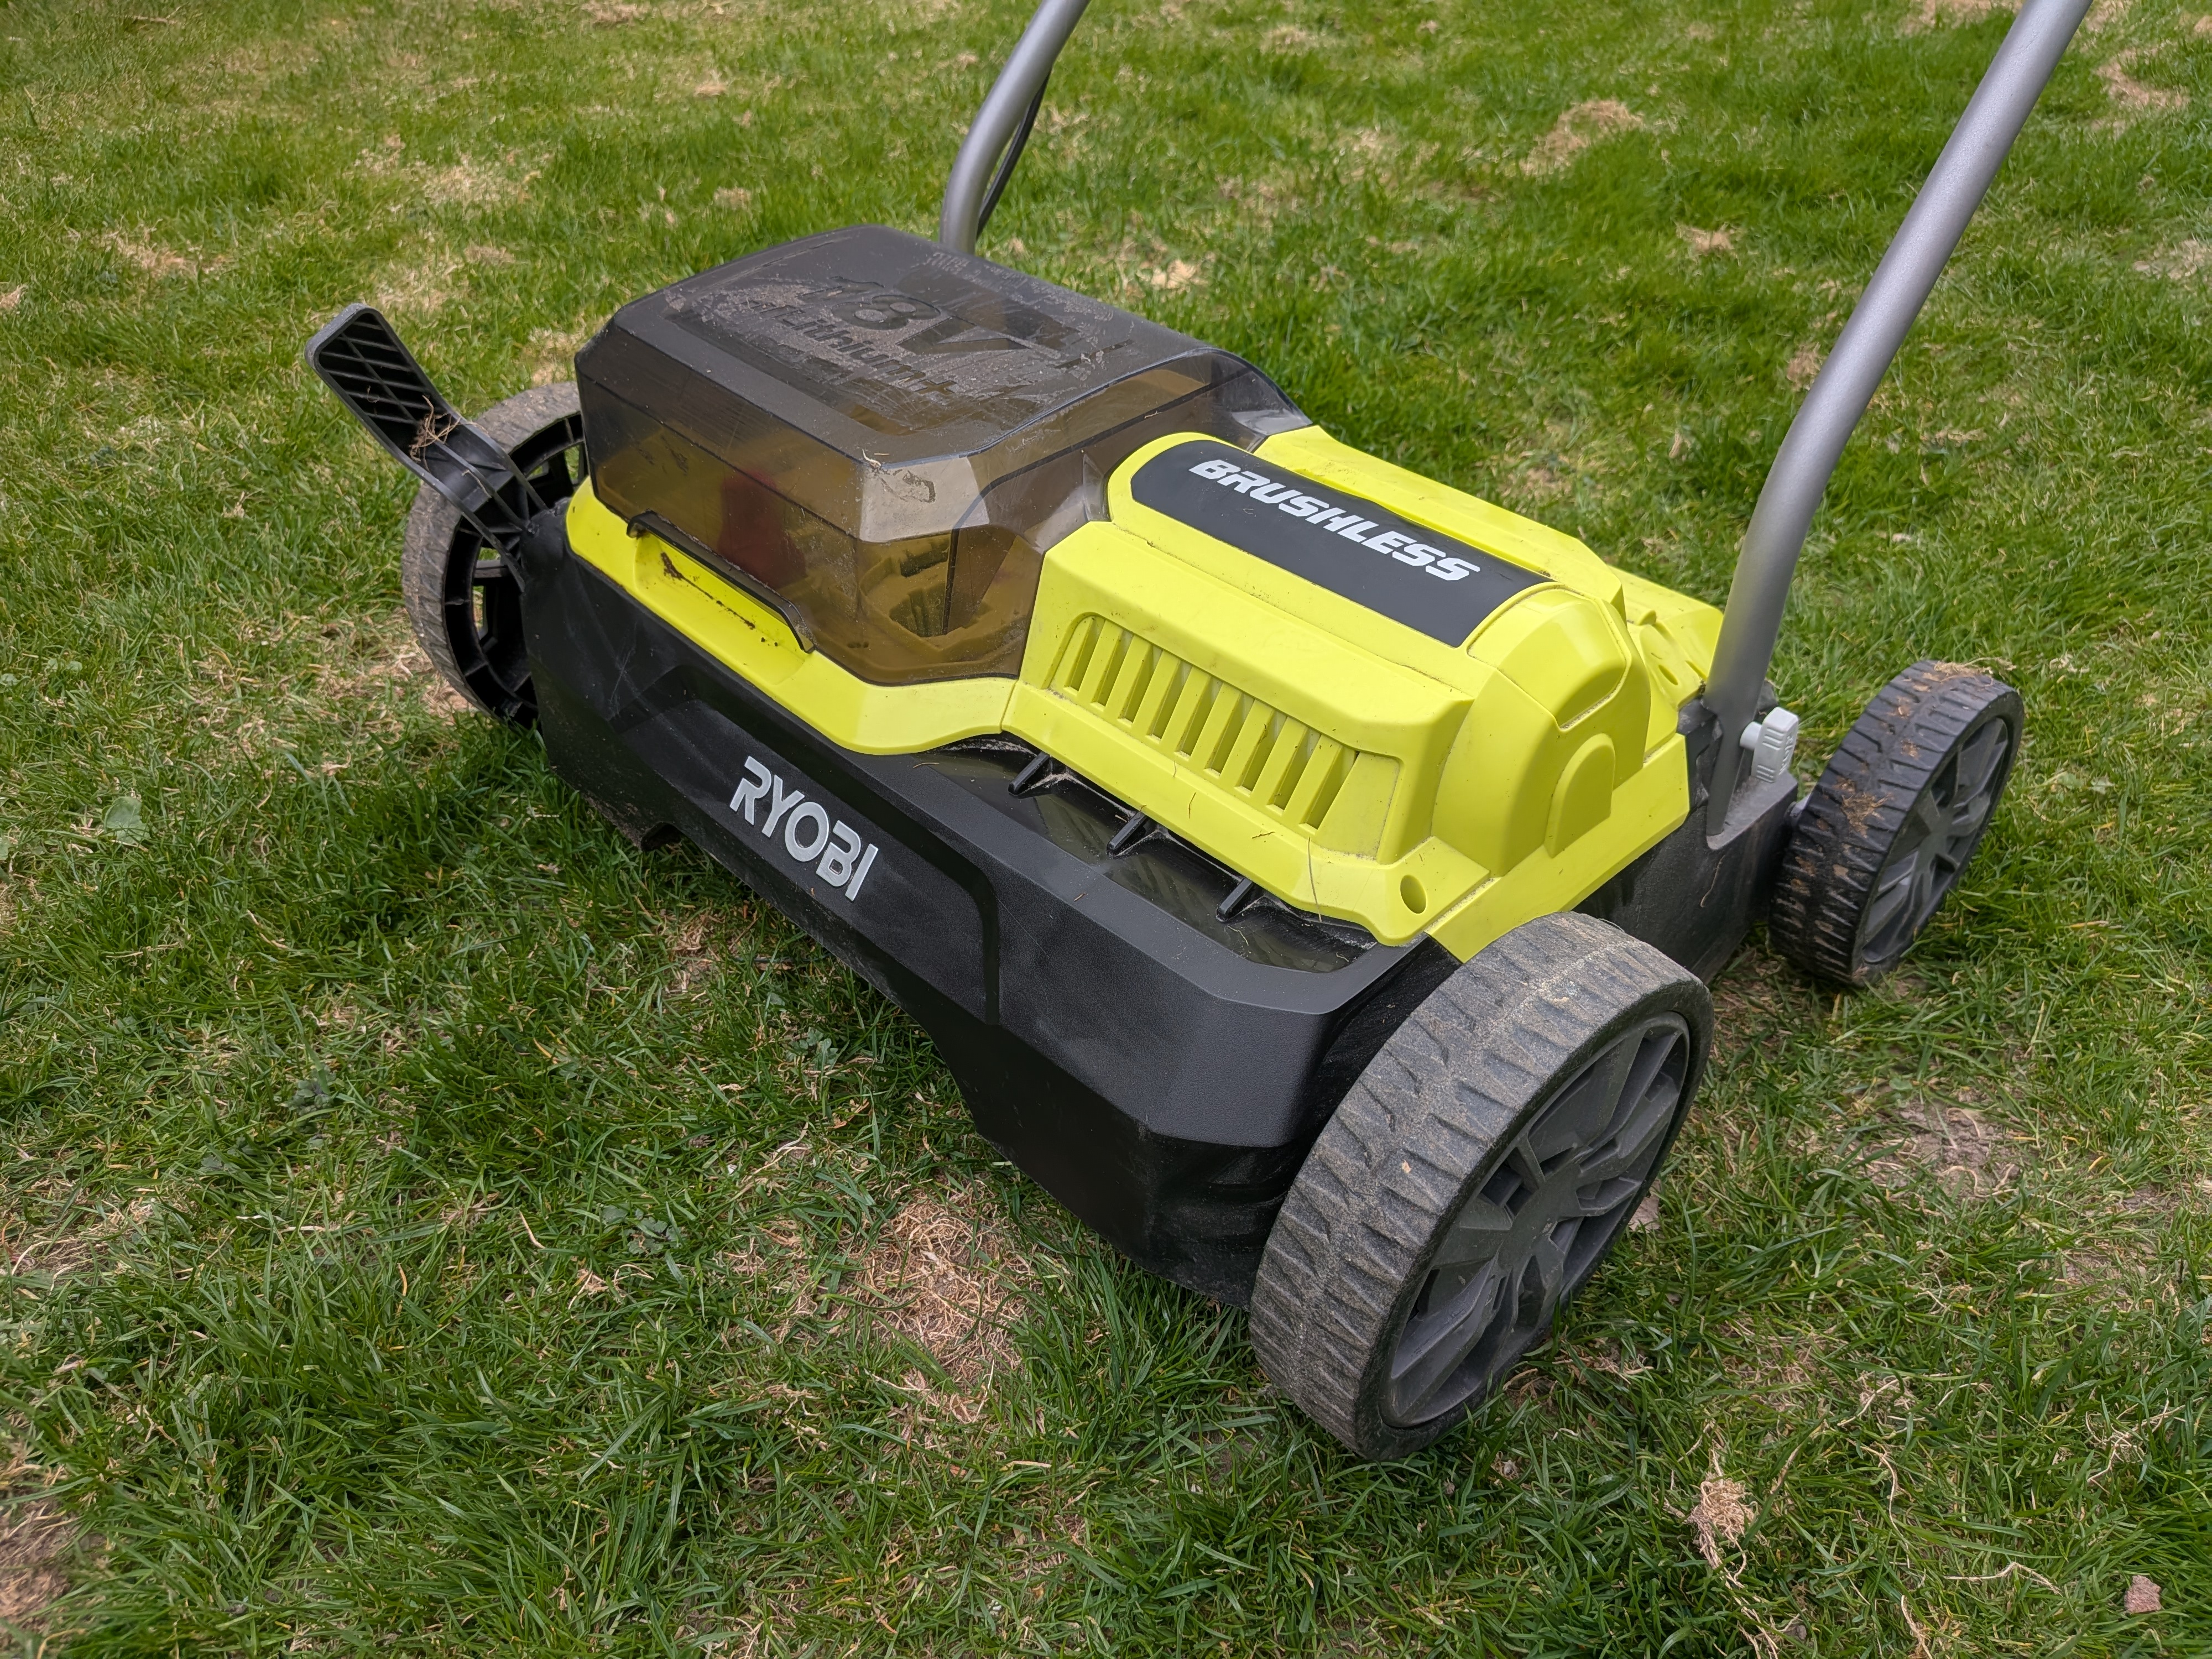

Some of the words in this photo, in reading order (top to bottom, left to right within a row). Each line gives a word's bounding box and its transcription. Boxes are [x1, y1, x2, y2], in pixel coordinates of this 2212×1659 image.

[795, 276, 1032, 356] 18V
[1188, 459, 1481, 581] BRUSHLESS
[729, 755, 879, 901] RYOBI
